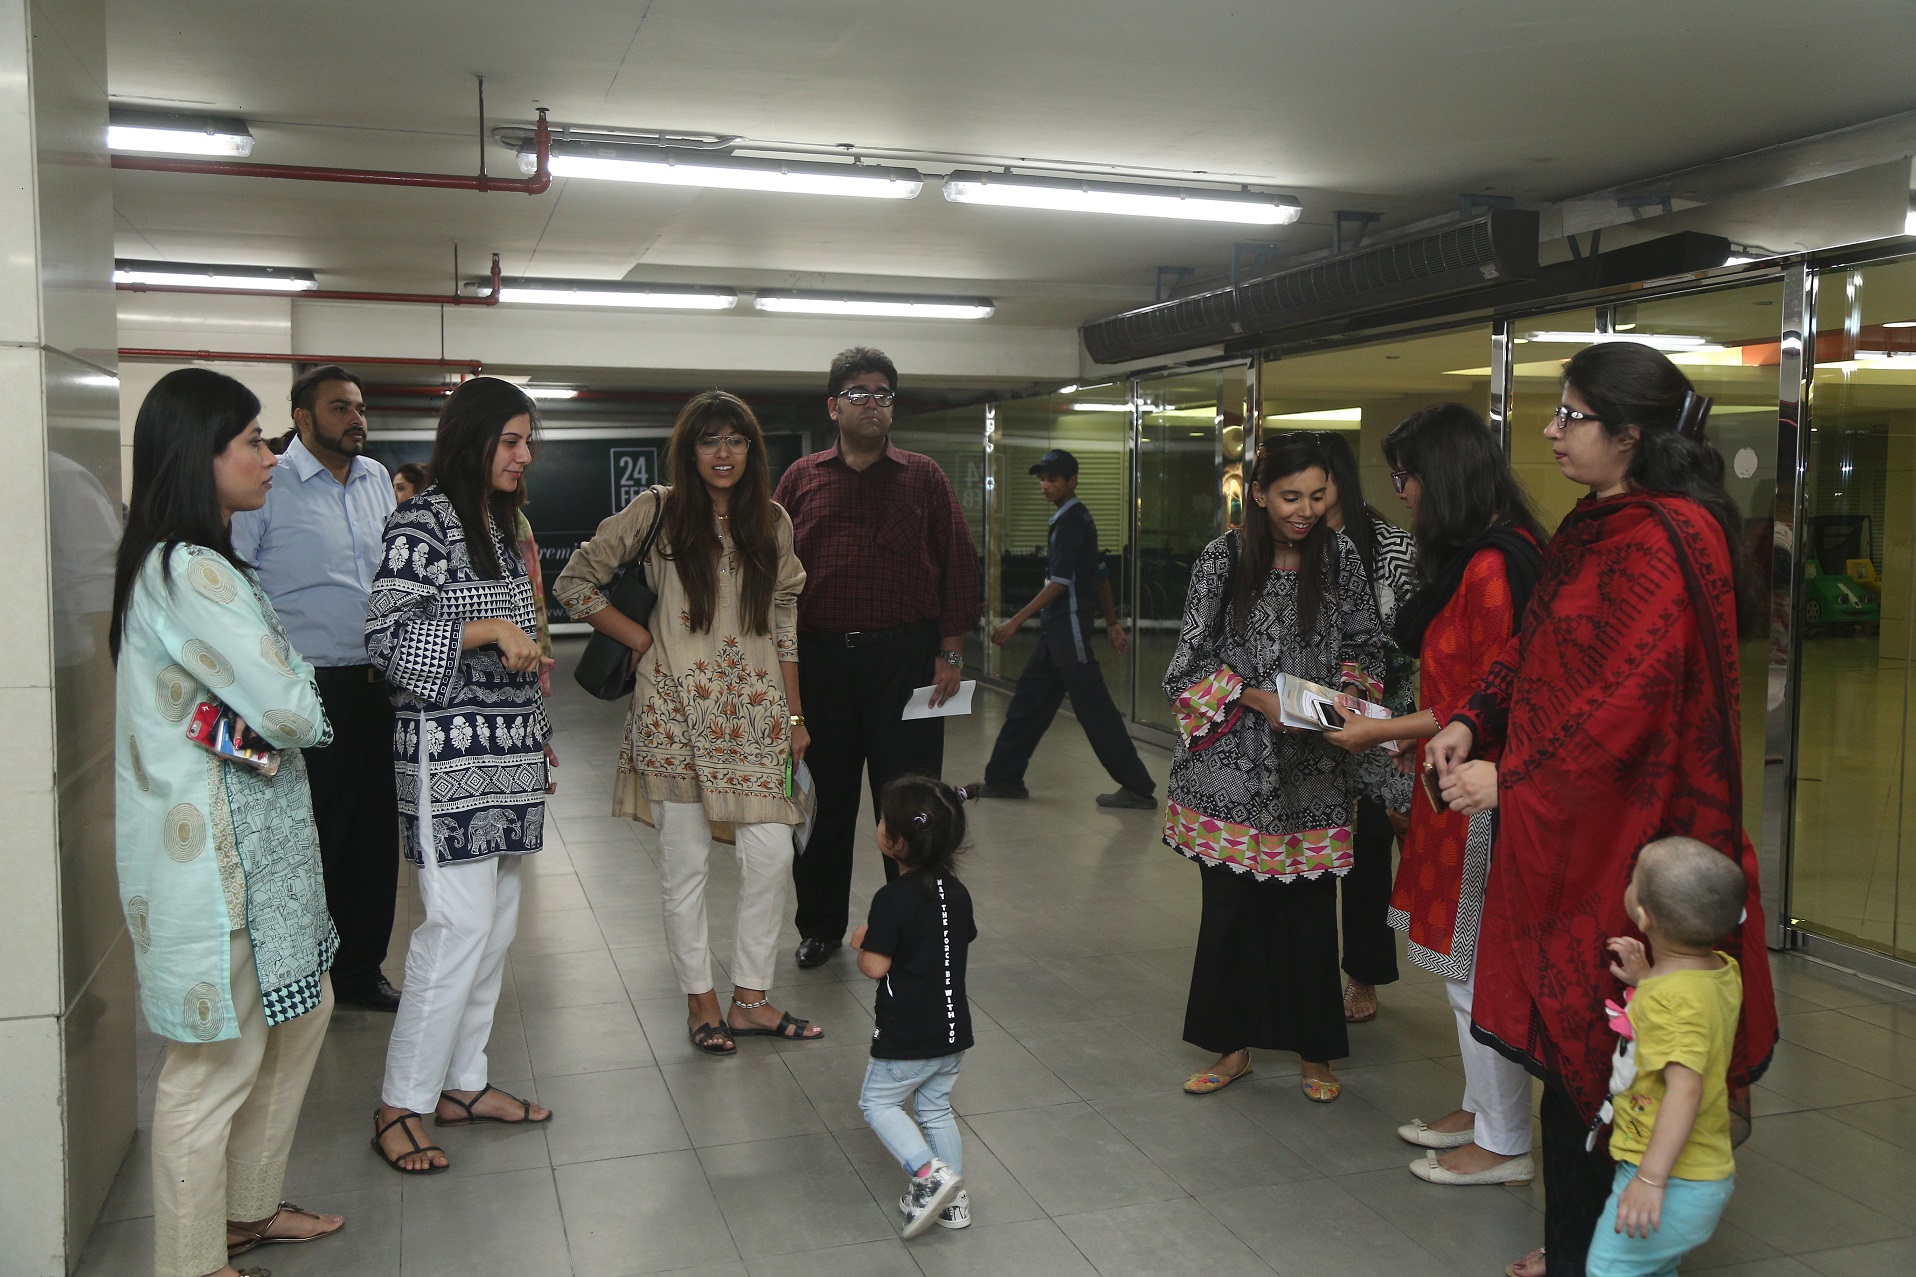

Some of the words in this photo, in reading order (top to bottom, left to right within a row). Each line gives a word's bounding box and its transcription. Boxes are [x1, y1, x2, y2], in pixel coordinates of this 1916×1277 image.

[619, 456, 649, 485] 24
[620, 486, 649, 507] FE
[940, 904, 949, 926] THE
[944, 970, 951, 985] BE
[944, 989, 956, 1019] WITH
[948, 1022, 956, 1044] YOU
